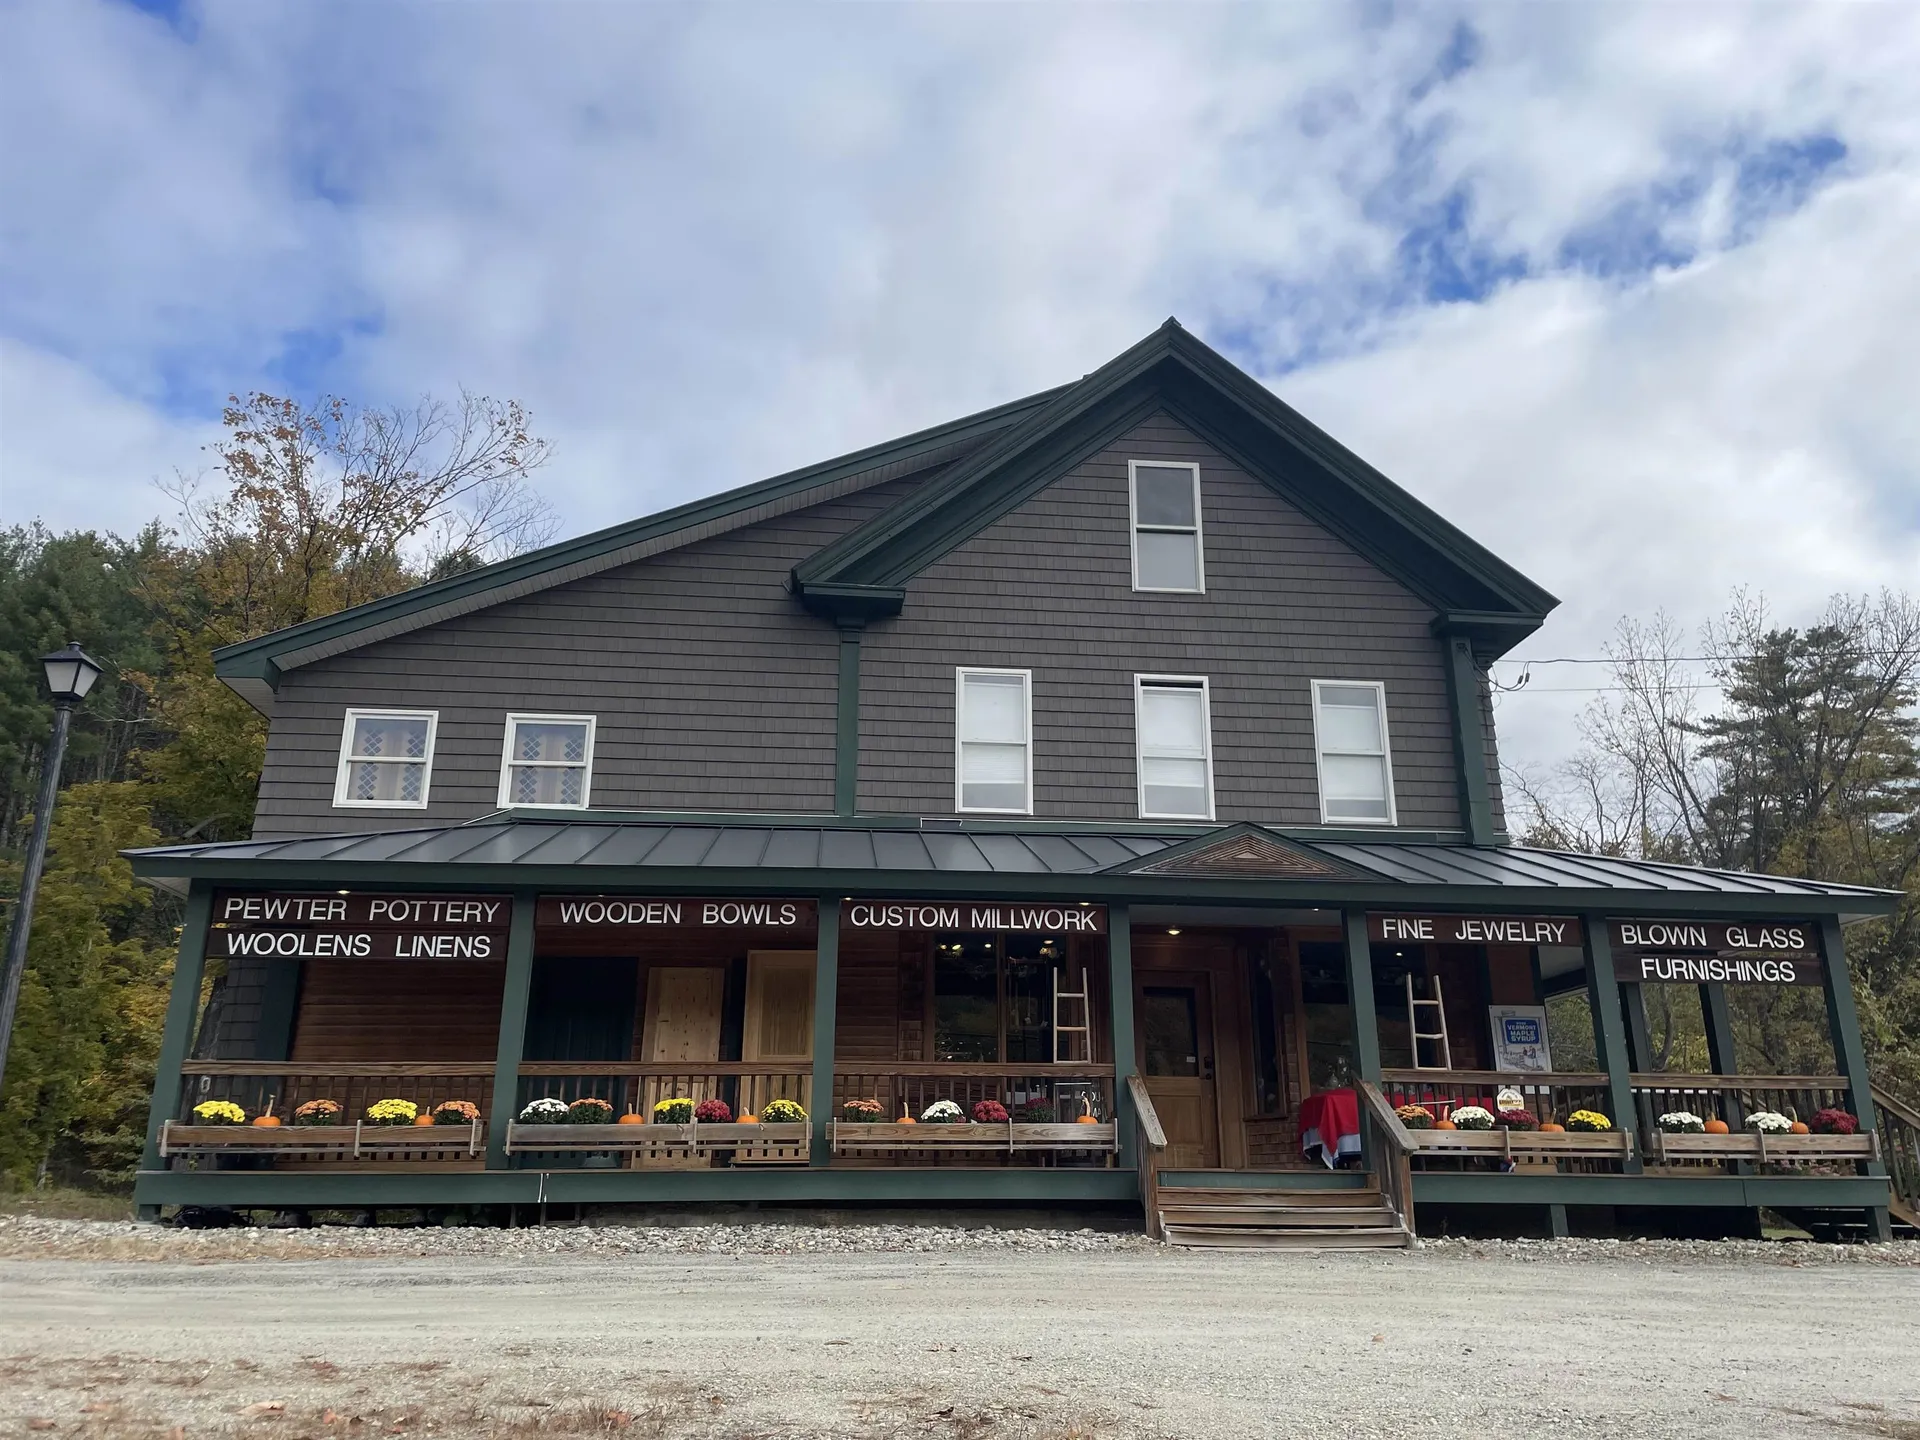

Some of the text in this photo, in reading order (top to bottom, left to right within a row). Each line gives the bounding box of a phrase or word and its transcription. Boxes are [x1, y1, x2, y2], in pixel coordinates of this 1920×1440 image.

[224, 898, 500, 923] PEWTER POTTERY
[560, 904, 796, 925] WOODEN BOWLS
[850, 906, 1098, 931] CUSTOM MILLWORK
[1382, 919, 1566, 943] FINE JEWELRY
[1621, 925, 1805, 949] BLOWN GLASS
[227, 932, 491, 958] WOOLENS LINENS
[1640, 958, 1796, 982] FURNISHINGS
